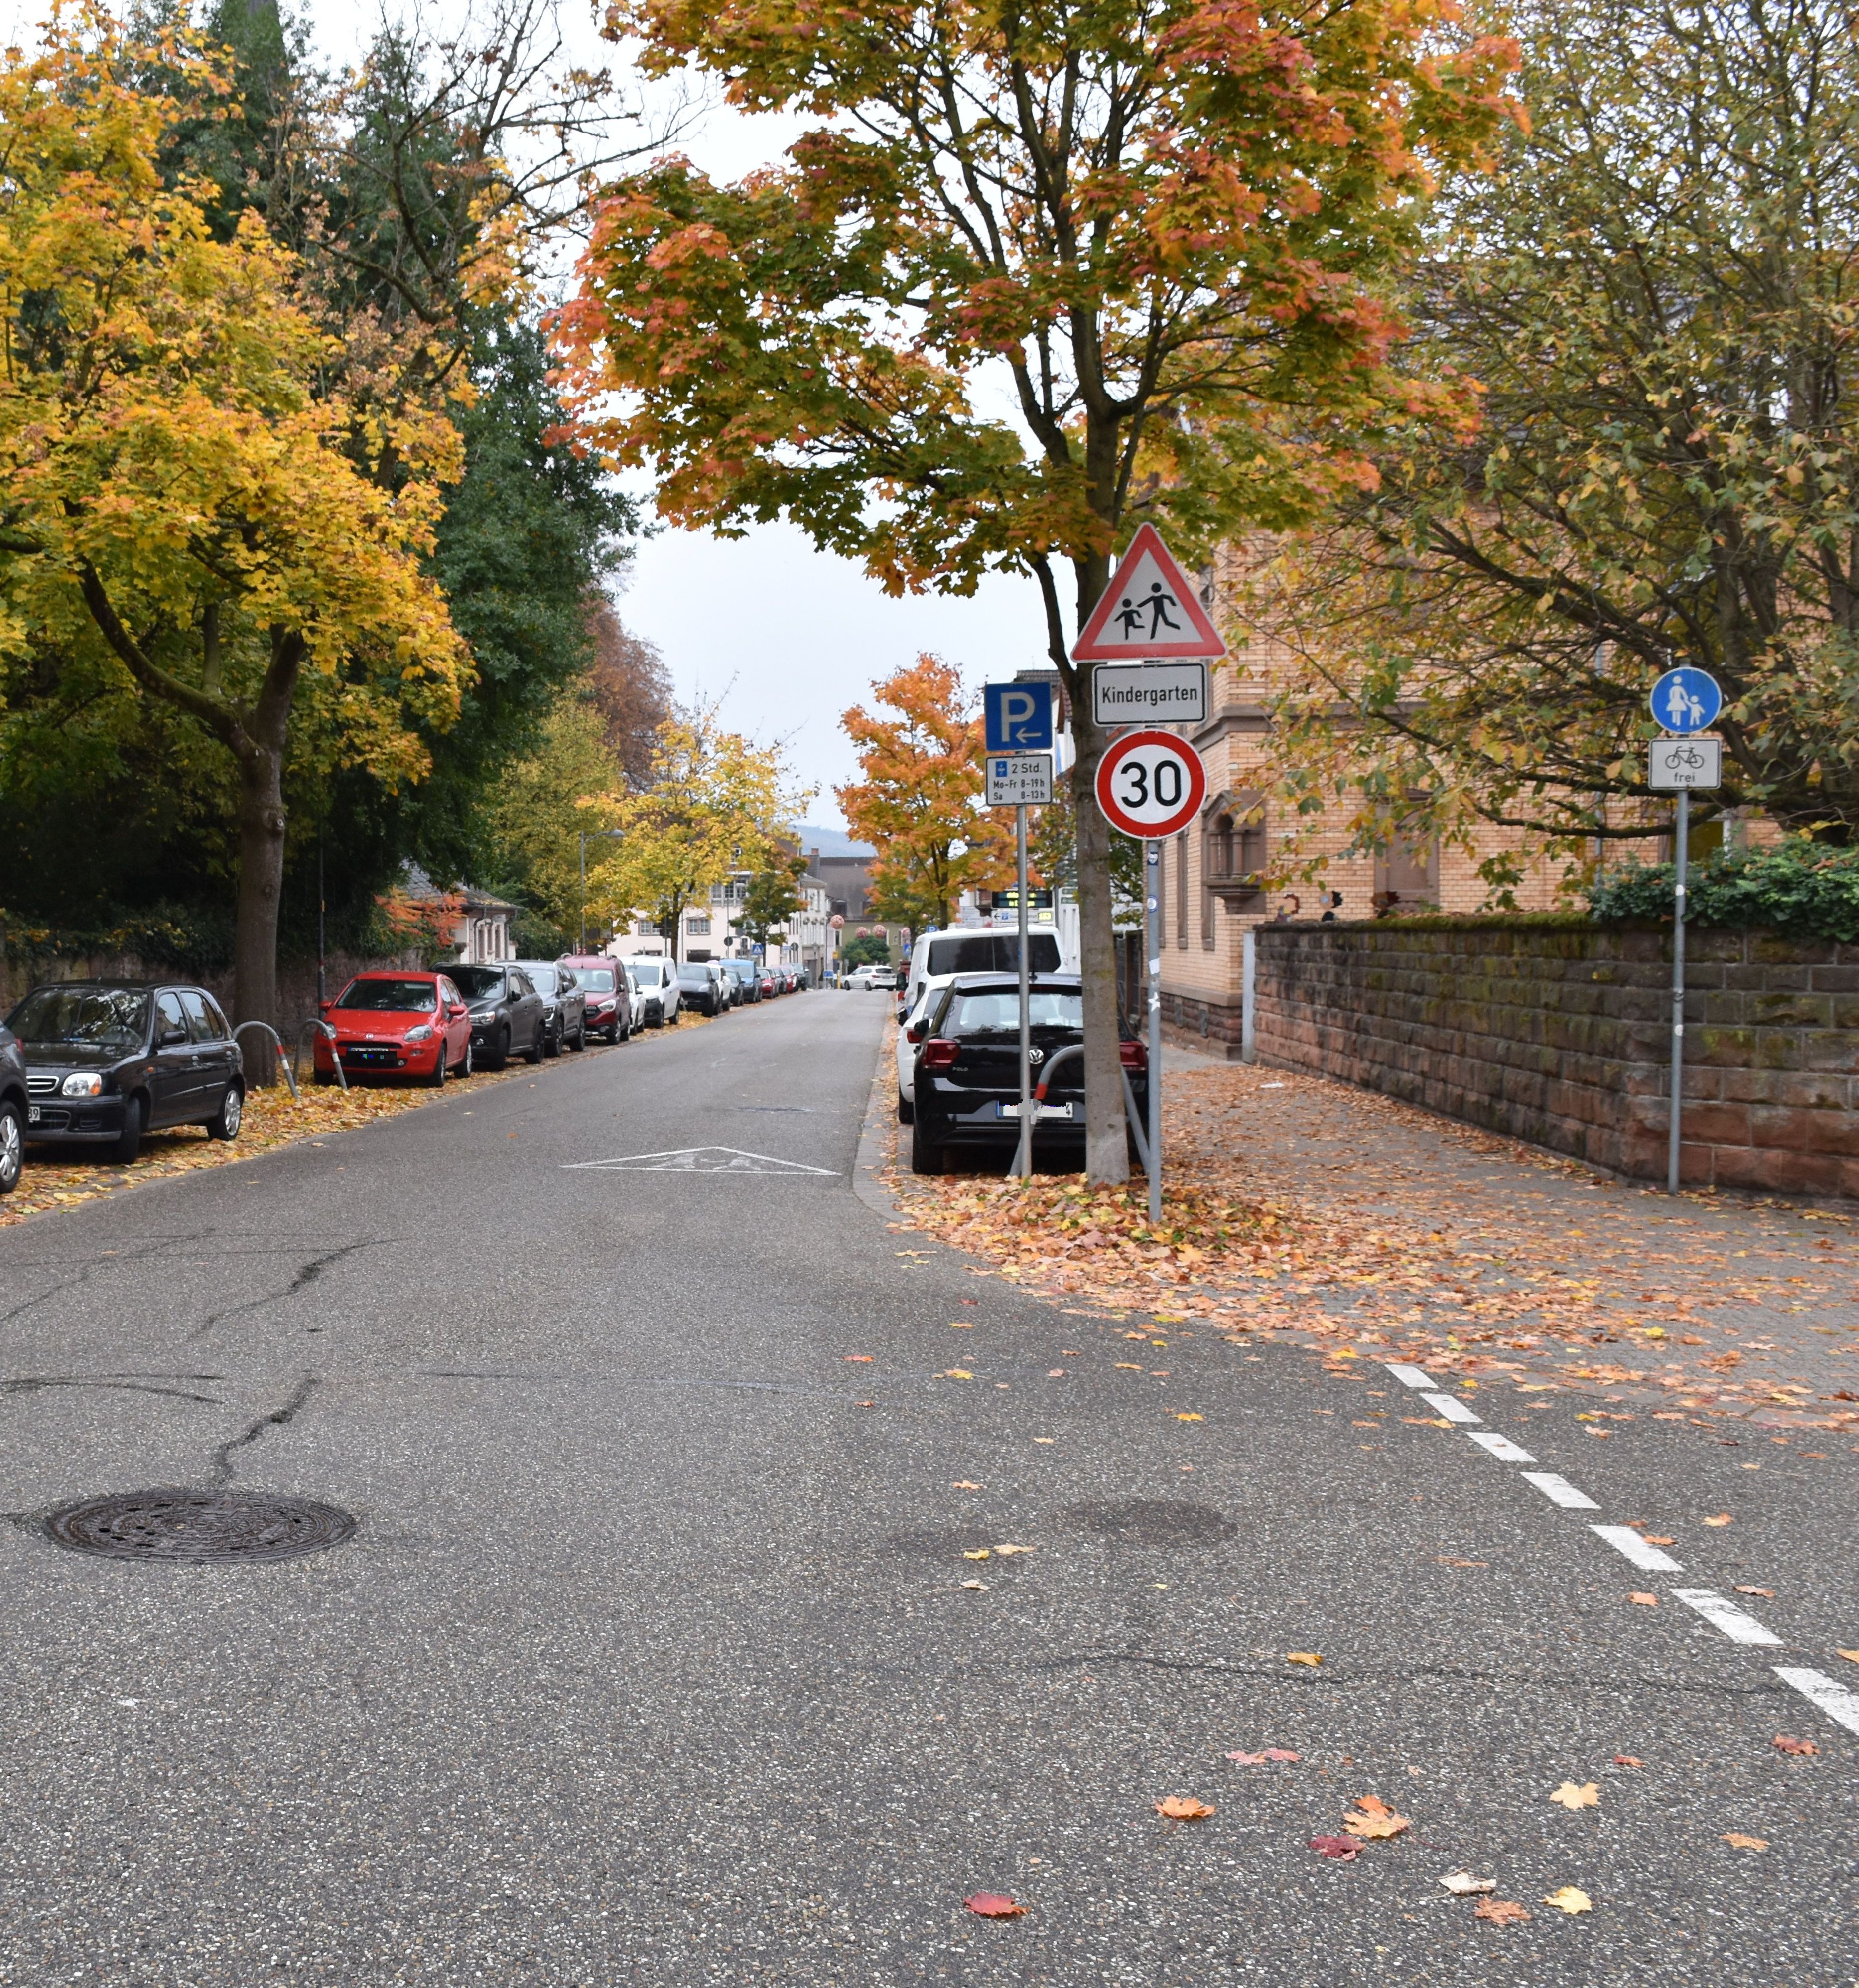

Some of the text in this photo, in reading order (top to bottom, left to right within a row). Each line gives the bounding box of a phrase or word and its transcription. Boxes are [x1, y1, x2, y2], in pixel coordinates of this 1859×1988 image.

[1102, 685, 1197, 706] Kindergarten
[1001, 692, 1035, 742] P
[1012, 762, 1042, 774] 2 Std.
[993, 779, 1017, 789] Mo-Fr
[1121, 760, 1181, 808] 30
[1674, 773, 1695, 783] frei
[993, 792, 1003, 800] Sa
